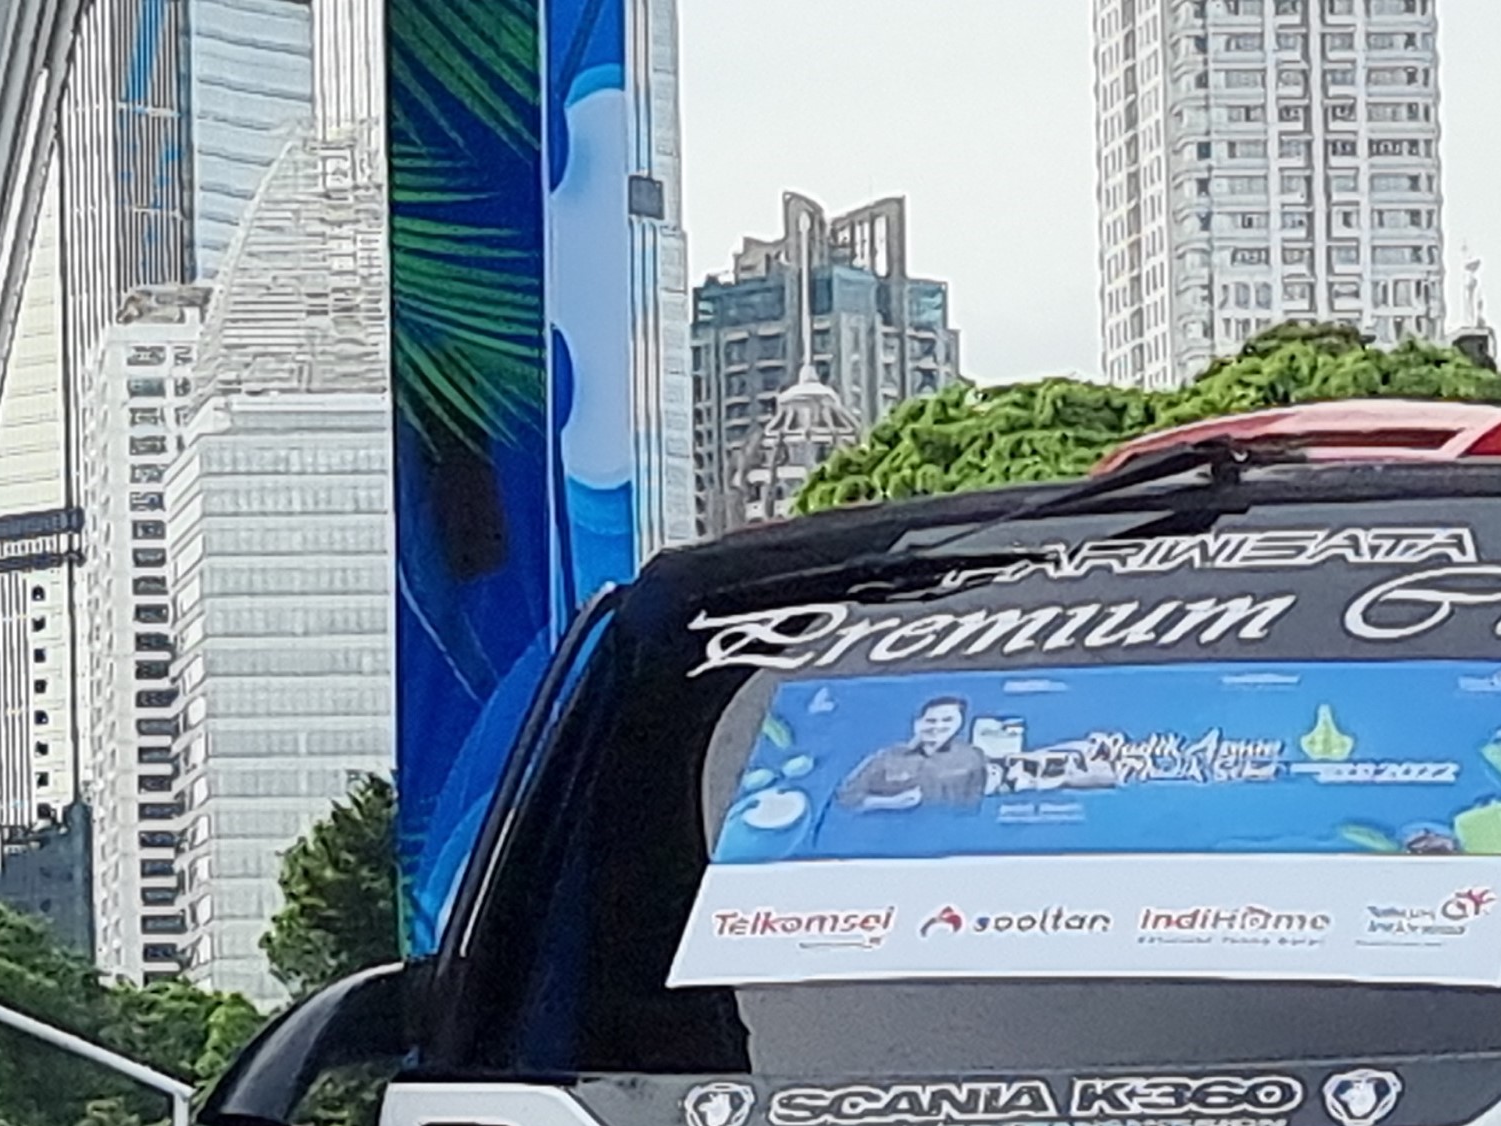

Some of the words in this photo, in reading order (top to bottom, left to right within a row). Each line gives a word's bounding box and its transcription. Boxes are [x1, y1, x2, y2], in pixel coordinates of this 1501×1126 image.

[940, 526, 1478, 586] ARIWISATA
[684, 594, 1297, 677] Premium
[768, 1080, 1058, 1126] SCANIA
[1070, 1076, 1304, 1117] K360
